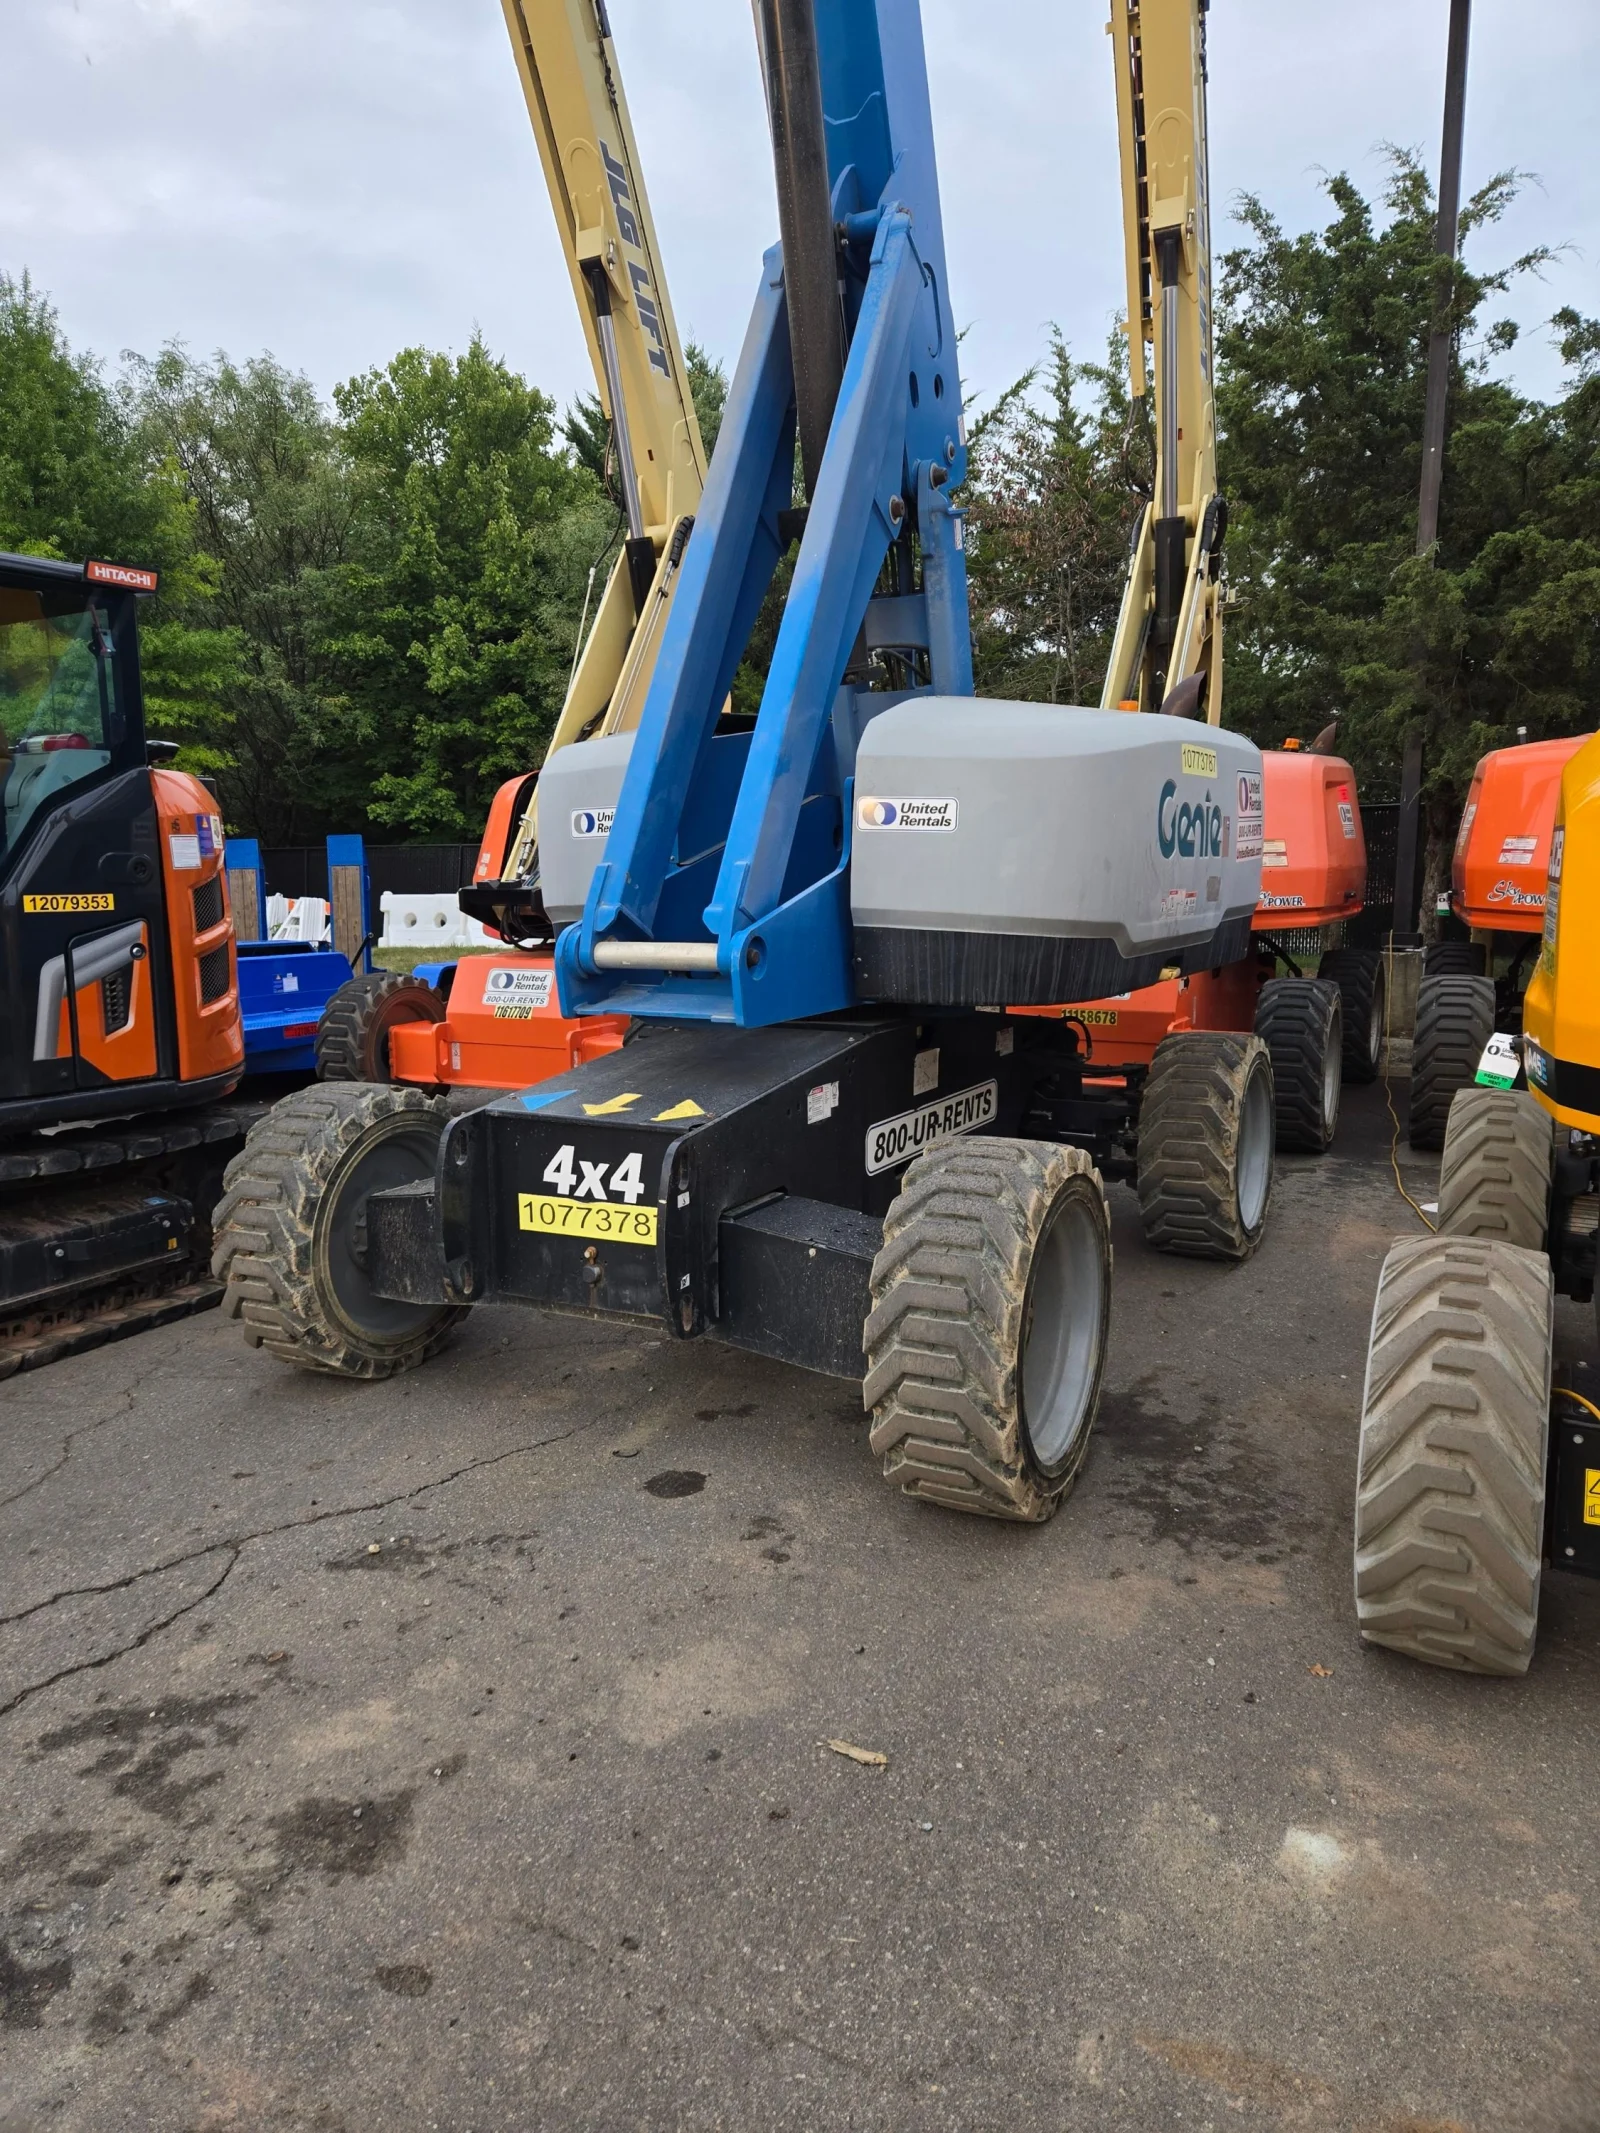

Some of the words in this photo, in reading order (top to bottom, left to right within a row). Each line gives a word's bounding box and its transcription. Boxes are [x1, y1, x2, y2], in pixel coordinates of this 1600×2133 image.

[600, 140, 641, 249] JLG
[627, 261, 671, 378] LIFT
[94, 566, 151, 586] HITACHI
[1183, 749, 1216, 773] 10773787
[900, 803, 948, 814] United
[597, 811, 616, 822] Uni
[899, 815, 952, 827] Rentals
[1158, 778, 1222, 860] Genie
[29, 895, 110, 911] 12079353
[517, 973, 548, 983] United
[514, 982, 548, 991] Rentals
[486, 995, 546, 1005] 800-UR-RENTS
[495, 1005, 532, 1019] 11617709
[1484, 1073, 1501, 1081] READY
[1487, 1079, 1502, 1087] RENT
[874, 1088, 992, 1163] 800-UR-RENTS
[543, 1144, 645, 1204] 4x4
[523, 1201, 657, 1237] 1077378
